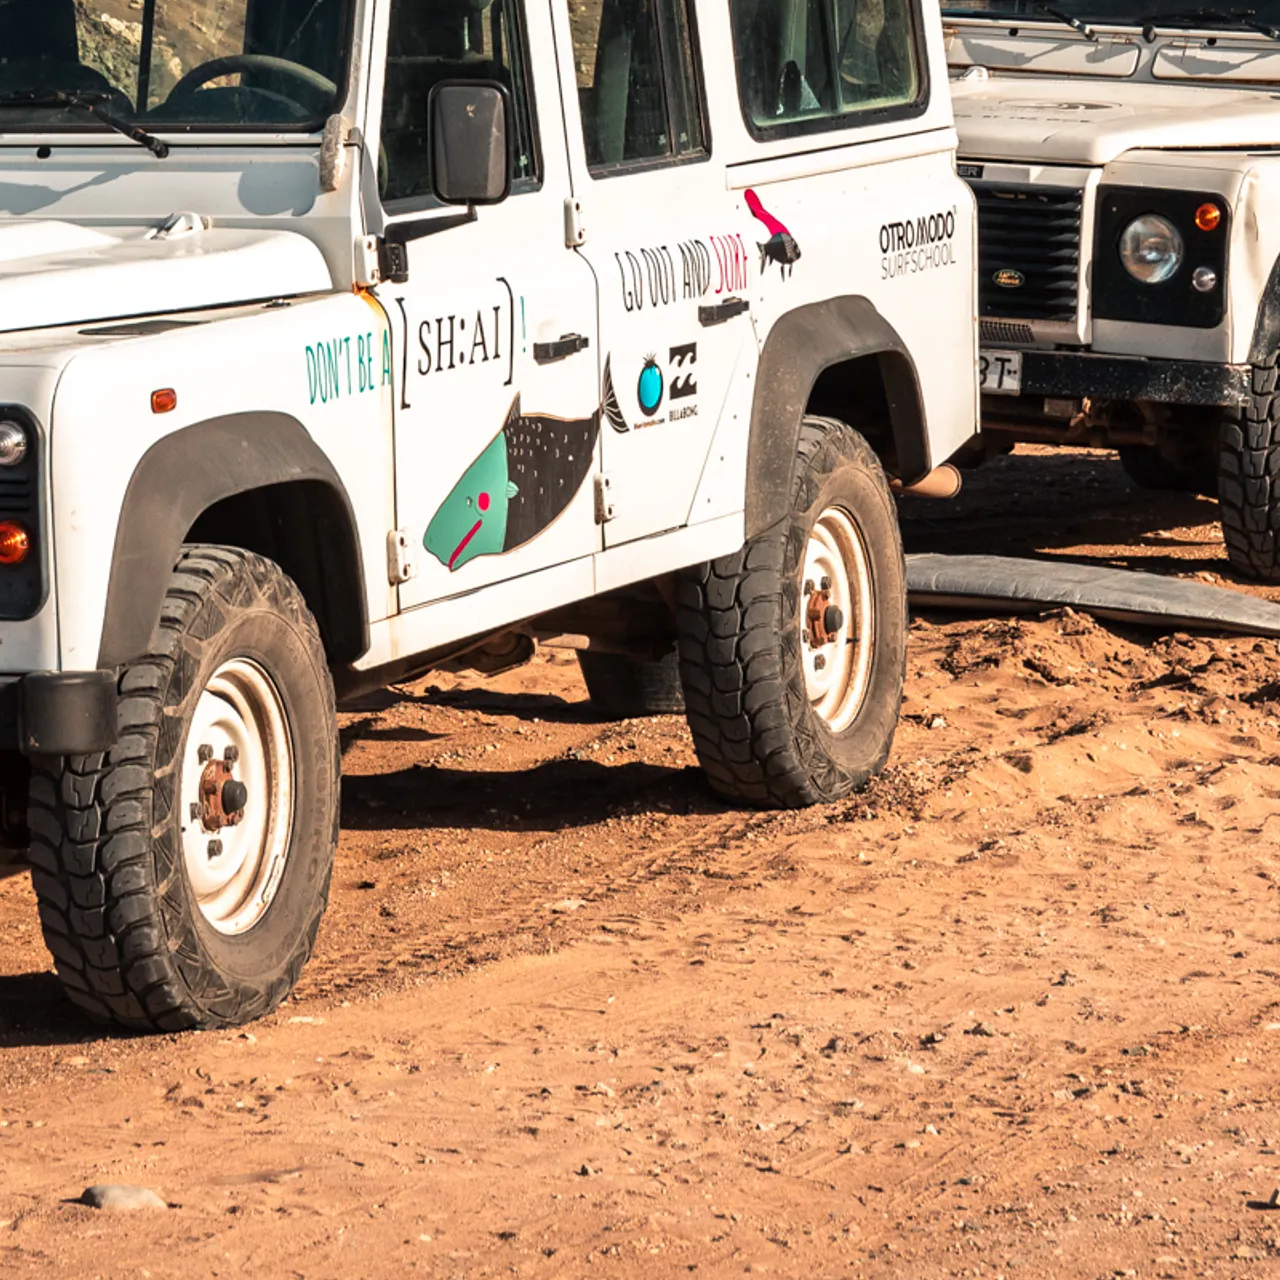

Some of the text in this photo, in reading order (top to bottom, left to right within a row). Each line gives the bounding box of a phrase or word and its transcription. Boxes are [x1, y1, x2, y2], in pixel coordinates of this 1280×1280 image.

[614, 250, 643, 312] GO
[639, 245, 677, 308] OUT
[677, 239, 711, 300] AND
[881, 242, 956, 280] SURFSCHOOL
[304, 335, 352, 406] DON'T
[357, 332, 375, 393] BE
[381, 328, 392, 387] A
